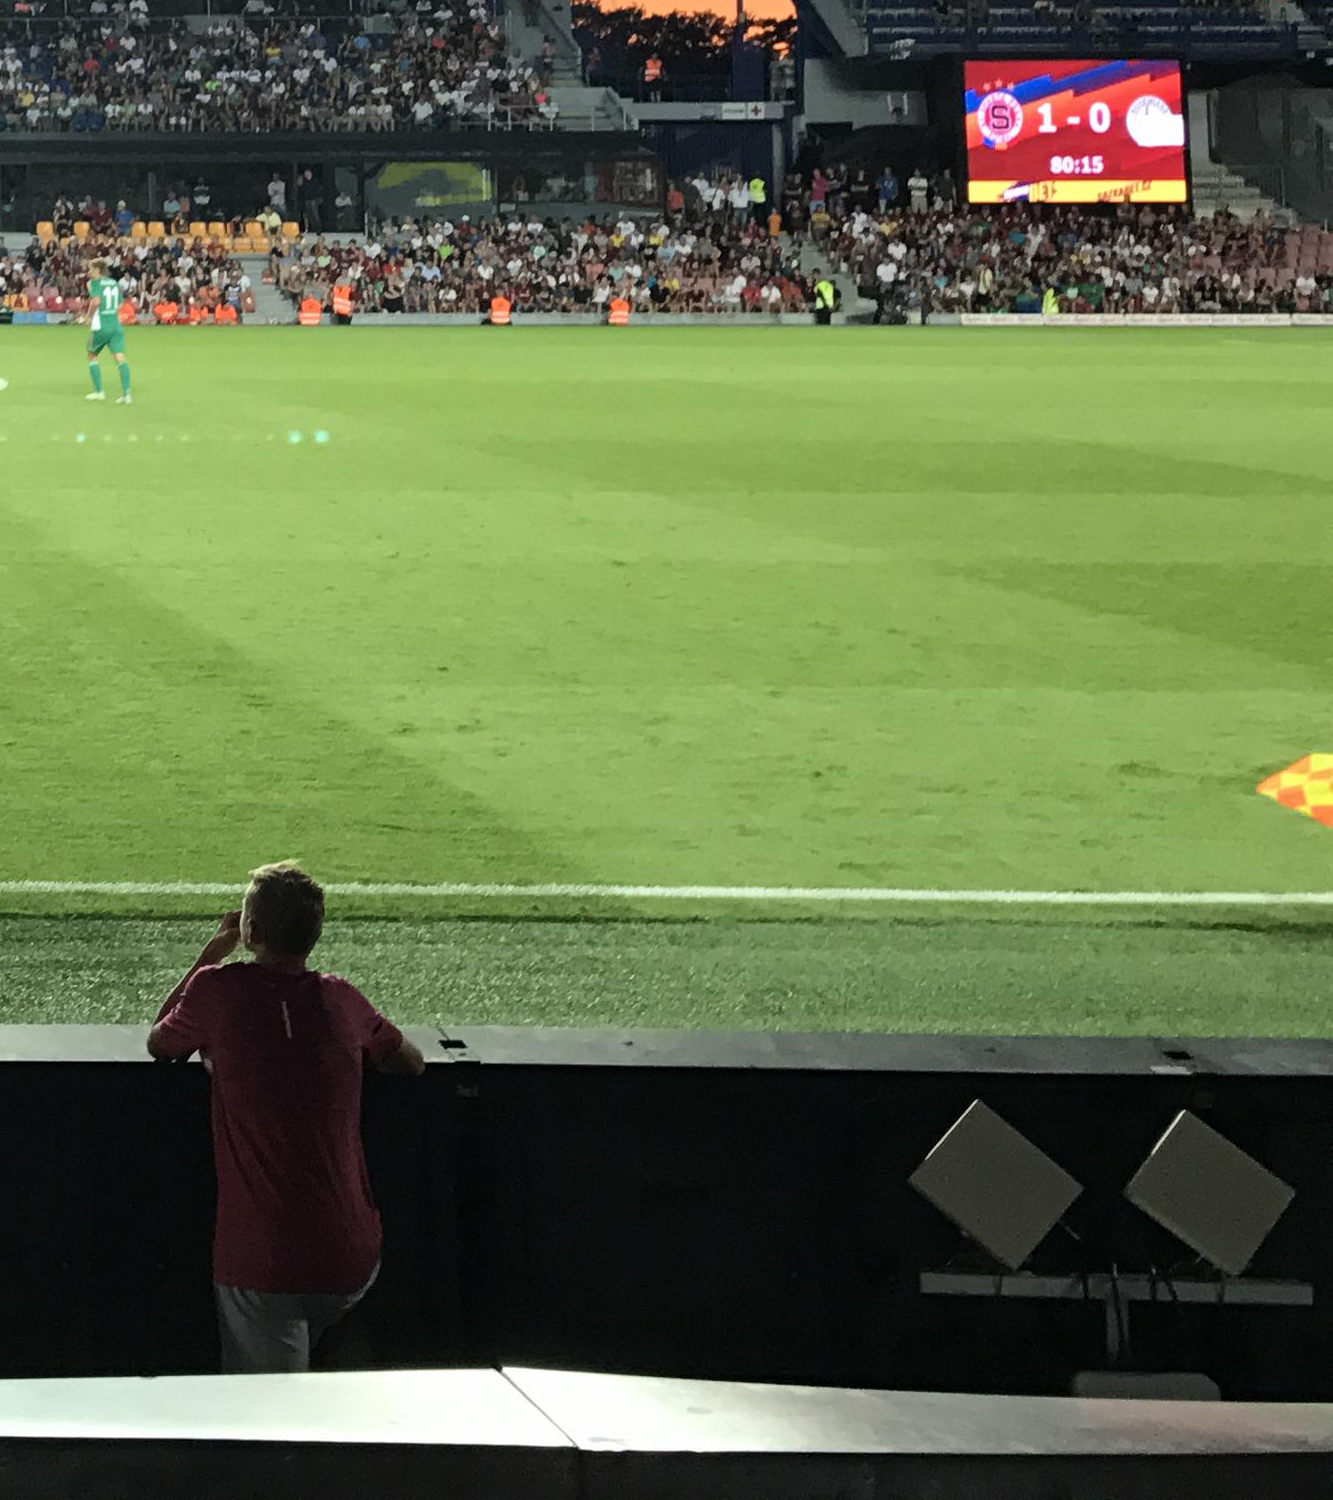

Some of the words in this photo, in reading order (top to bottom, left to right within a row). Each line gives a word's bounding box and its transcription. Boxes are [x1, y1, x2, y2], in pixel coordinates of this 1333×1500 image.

[1037, 102, 1057, 133] 1
[1089, 102, 1111, 133] 0
[1049, 155, 1104, 175] 80:15
[102, 286, 119, 310] 11
